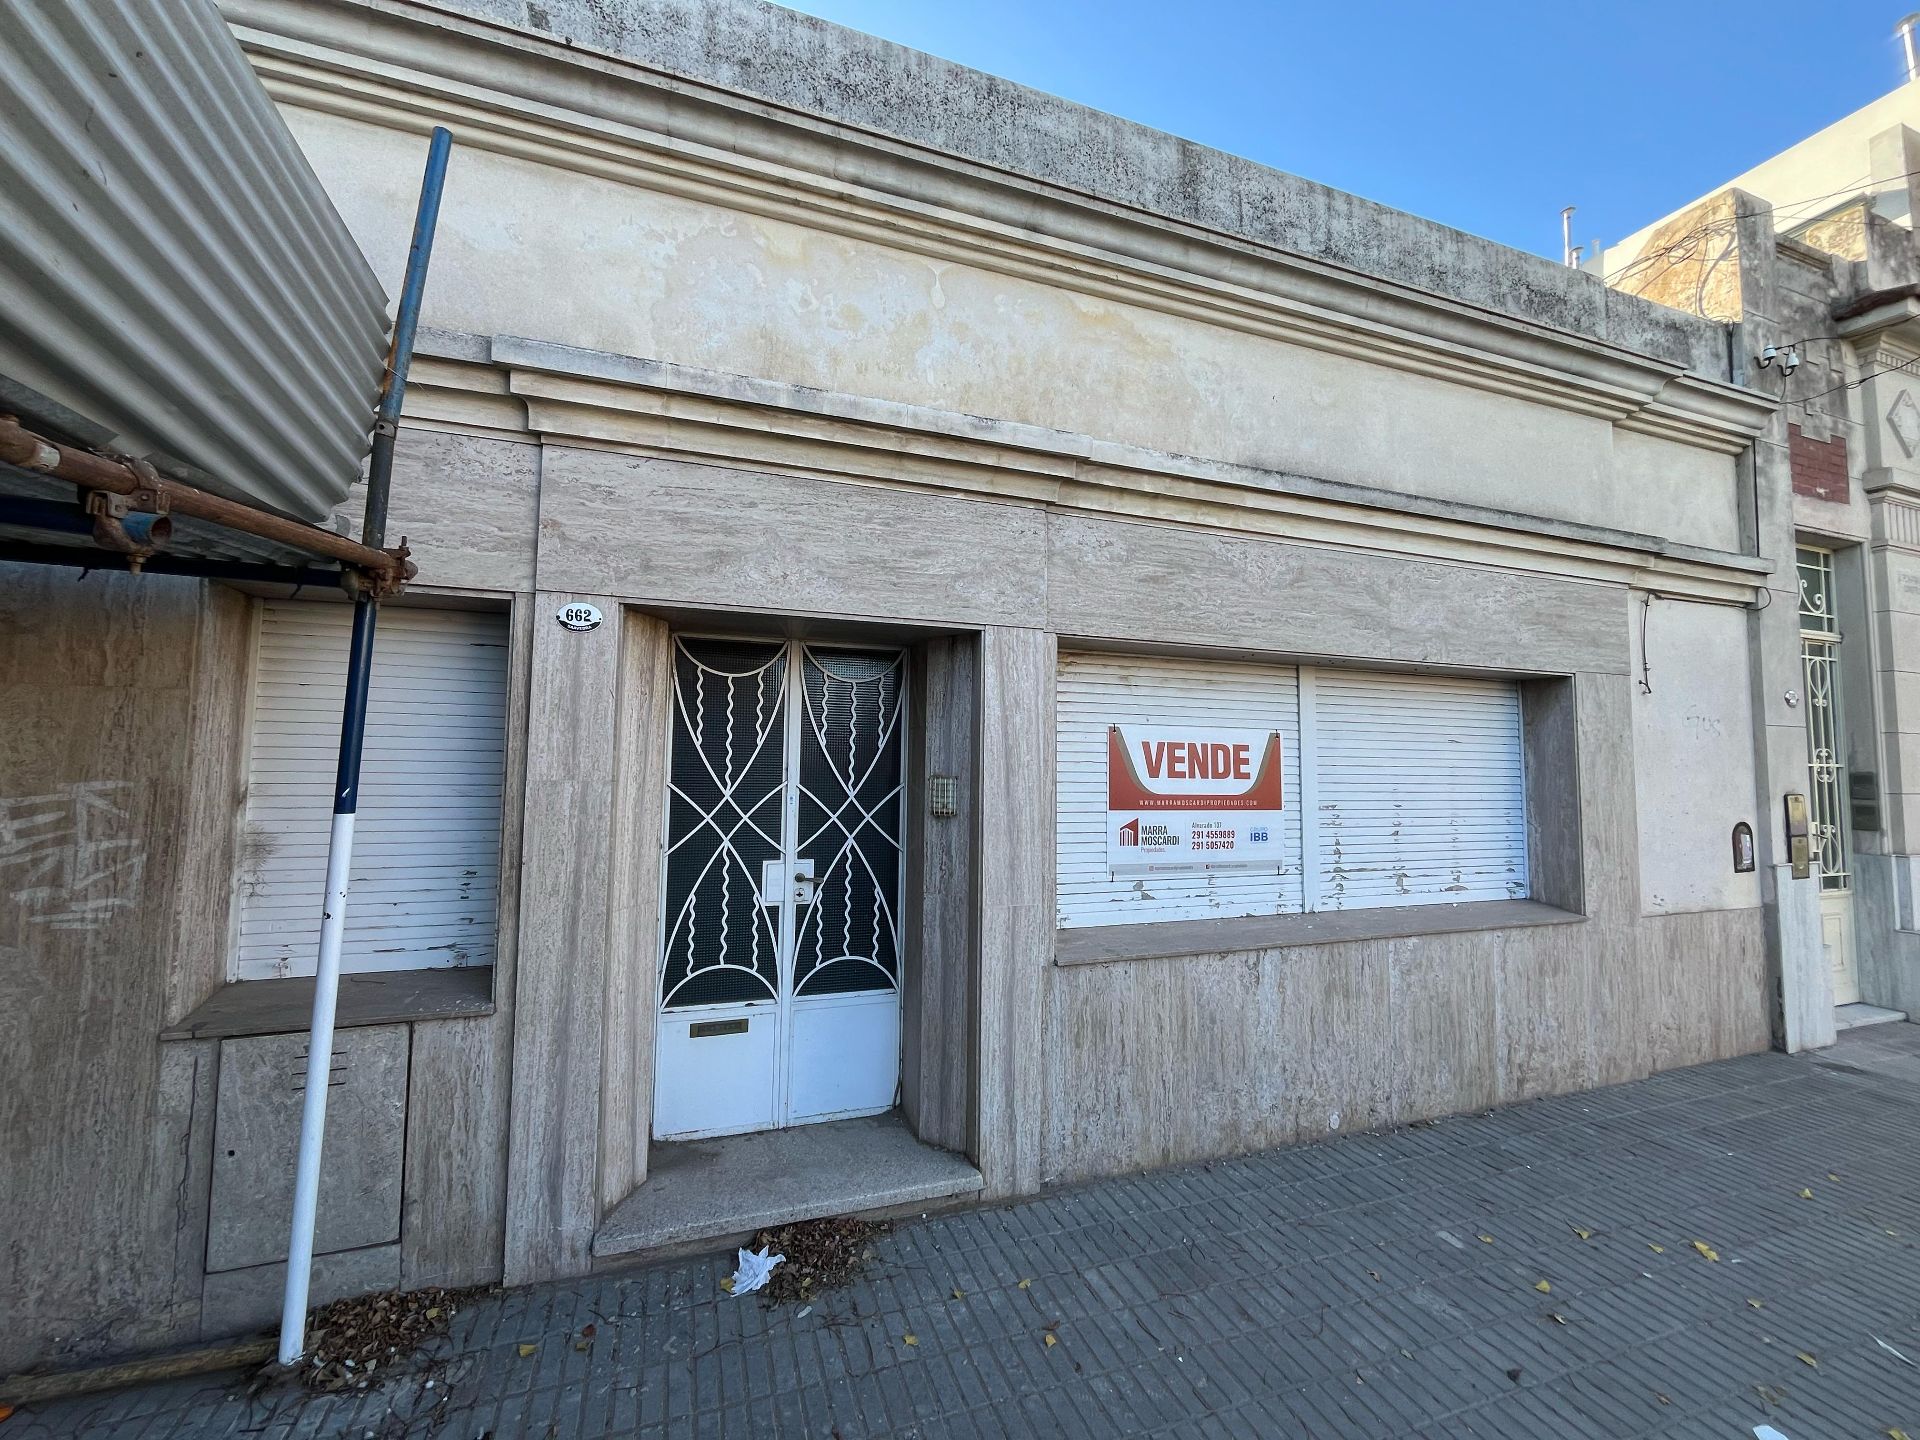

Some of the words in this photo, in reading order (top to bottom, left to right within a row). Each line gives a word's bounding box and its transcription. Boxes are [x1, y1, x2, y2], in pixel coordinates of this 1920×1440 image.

[565, 608, 592, 622] 662
[1141, 741, 1251, 780] VENDE
[1141, 825, 1168, 835] MARRA
[1191, 830, 1204, 839] 291
[1206, 830, 1235, 839] 4559889
[1141, 835, 1180, 846] MOSCARDI
[1250, 832, 1268, 842] IBB
[1191, 841, 1204, 850] 291
[1206, 840, 1234, 850] 5057420
